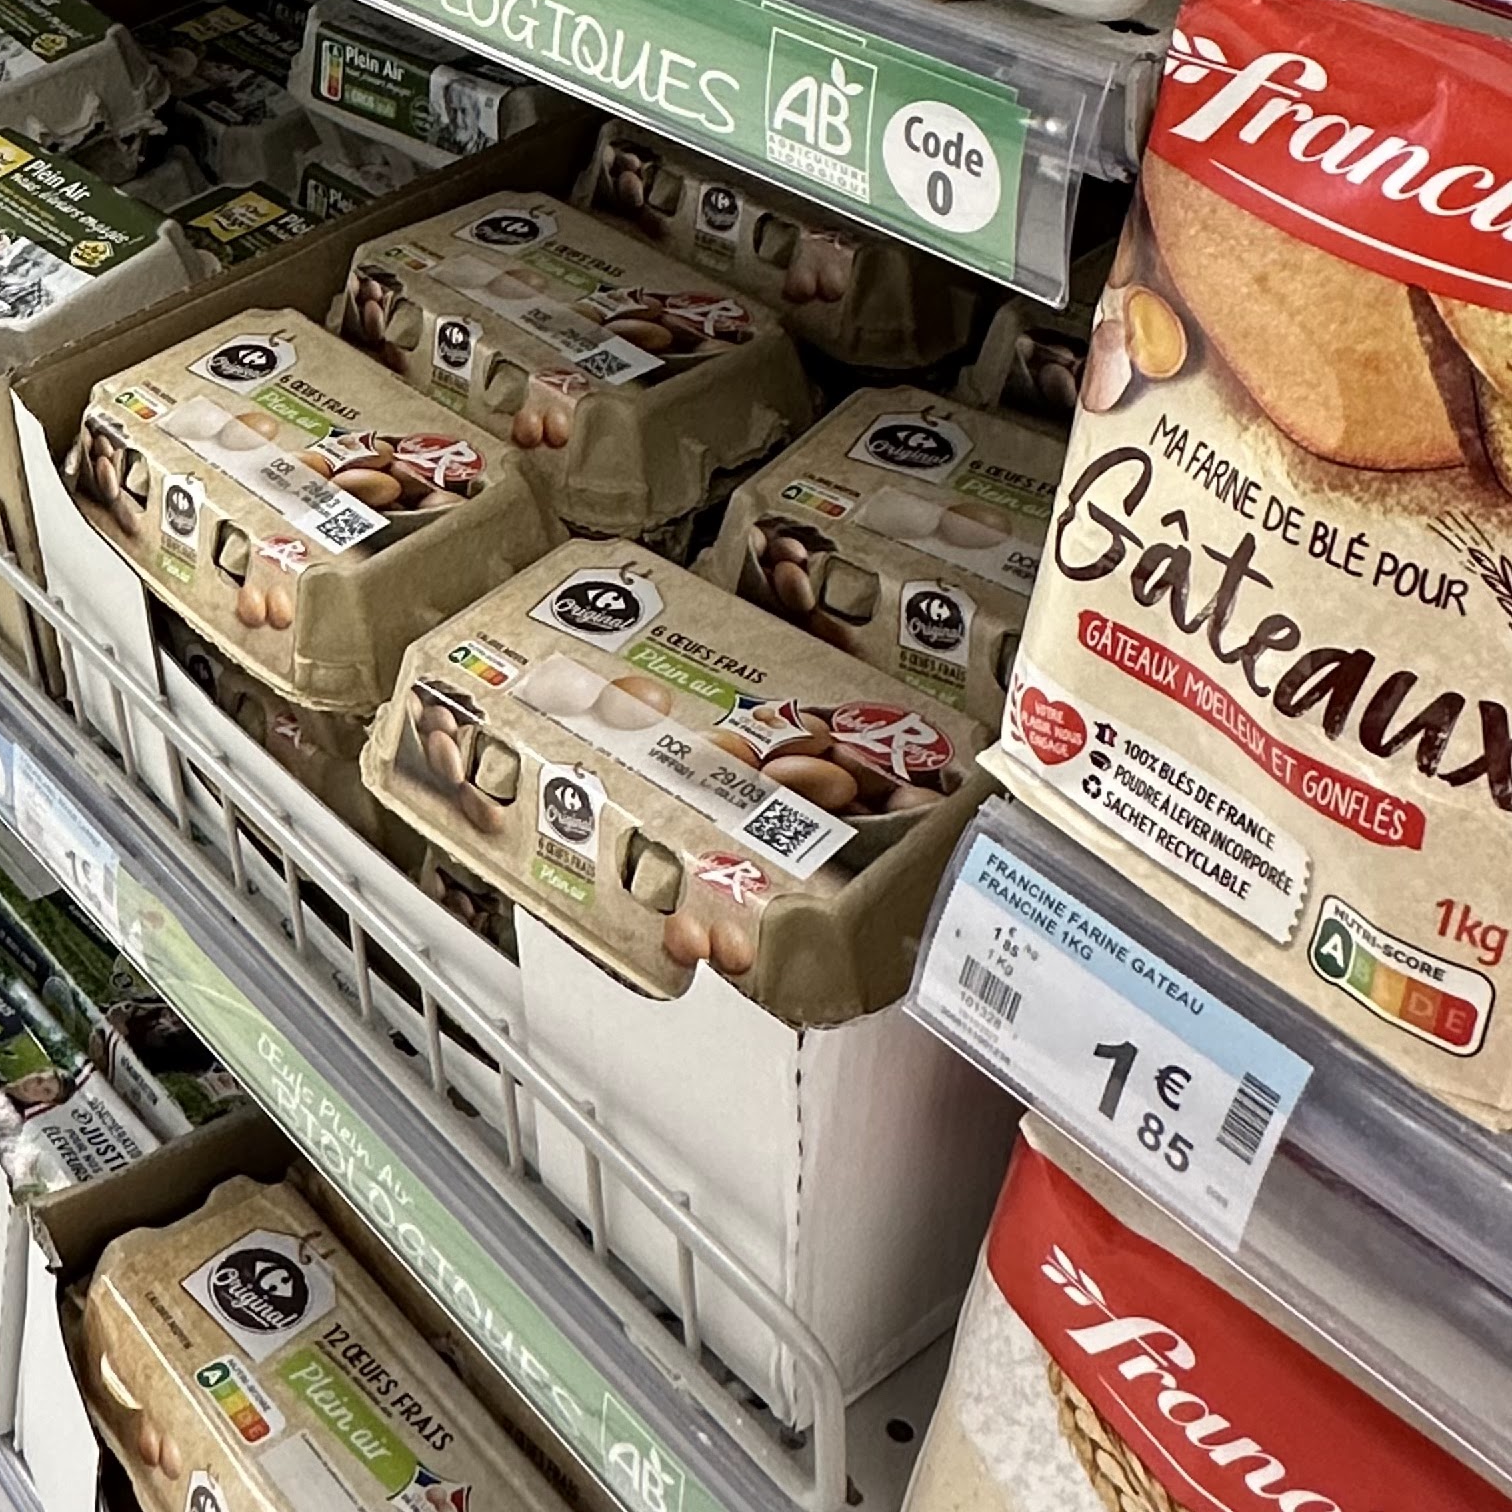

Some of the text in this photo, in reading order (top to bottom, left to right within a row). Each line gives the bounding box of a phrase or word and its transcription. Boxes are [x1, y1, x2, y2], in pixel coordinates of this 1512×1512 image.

[345, 45, 407, 82] Plein Air
[772, 73, 853, 157] AB
[903, 114, 985, 179] Code
[23, 158, 63, 190] Plein
[60, 177, 91, 202] Air
[926, 170, 954, 217] 0
[1149, 413, 1471, 617] MA FARINE DE BLÉ POUR
[554, 597, 637, 631] Original
[1054, 446, 1512, 813] Gâteaux
[631, 645, 726, 699] Plein air
[650, 625, 769, 685] 6 ŒUFS FRAIS
[1085, 612, 1408, 842] GÂTEAUX MOELLEUX ET GONFLÉS
[709, 765, 767, 804] 29/03
[1122, 739, 1276, 851] 100% BLÉS DE FRANCE
[1102, 791, 1252, 901] SACHET RECYCLABLE
[1113, 764, 1295, 896] POUDRE À LEVER INCORPORÉE
[978, 869, 1093, 963] FRANCINE 1KG
[986, 852, 1205, 1016] FRANCINE FARINE GATEAU
[1002, 939, 1021, 958] 85
[1320, 932, 1346, 969] A
[1333, 904, 1447, 982] NUTRI-SCORE
[1435, 898, 1510, 967] 1kg
[1091, 1039, 1194, 1121] 1 €
[1136, 1113, 1195, 1174] 85
[213, 1267, 299, 1330] Original
[288, 1361, 393, 1461] Plein air
[321, 1323, 455, 1452] 12 ŒUFS FRAIS
